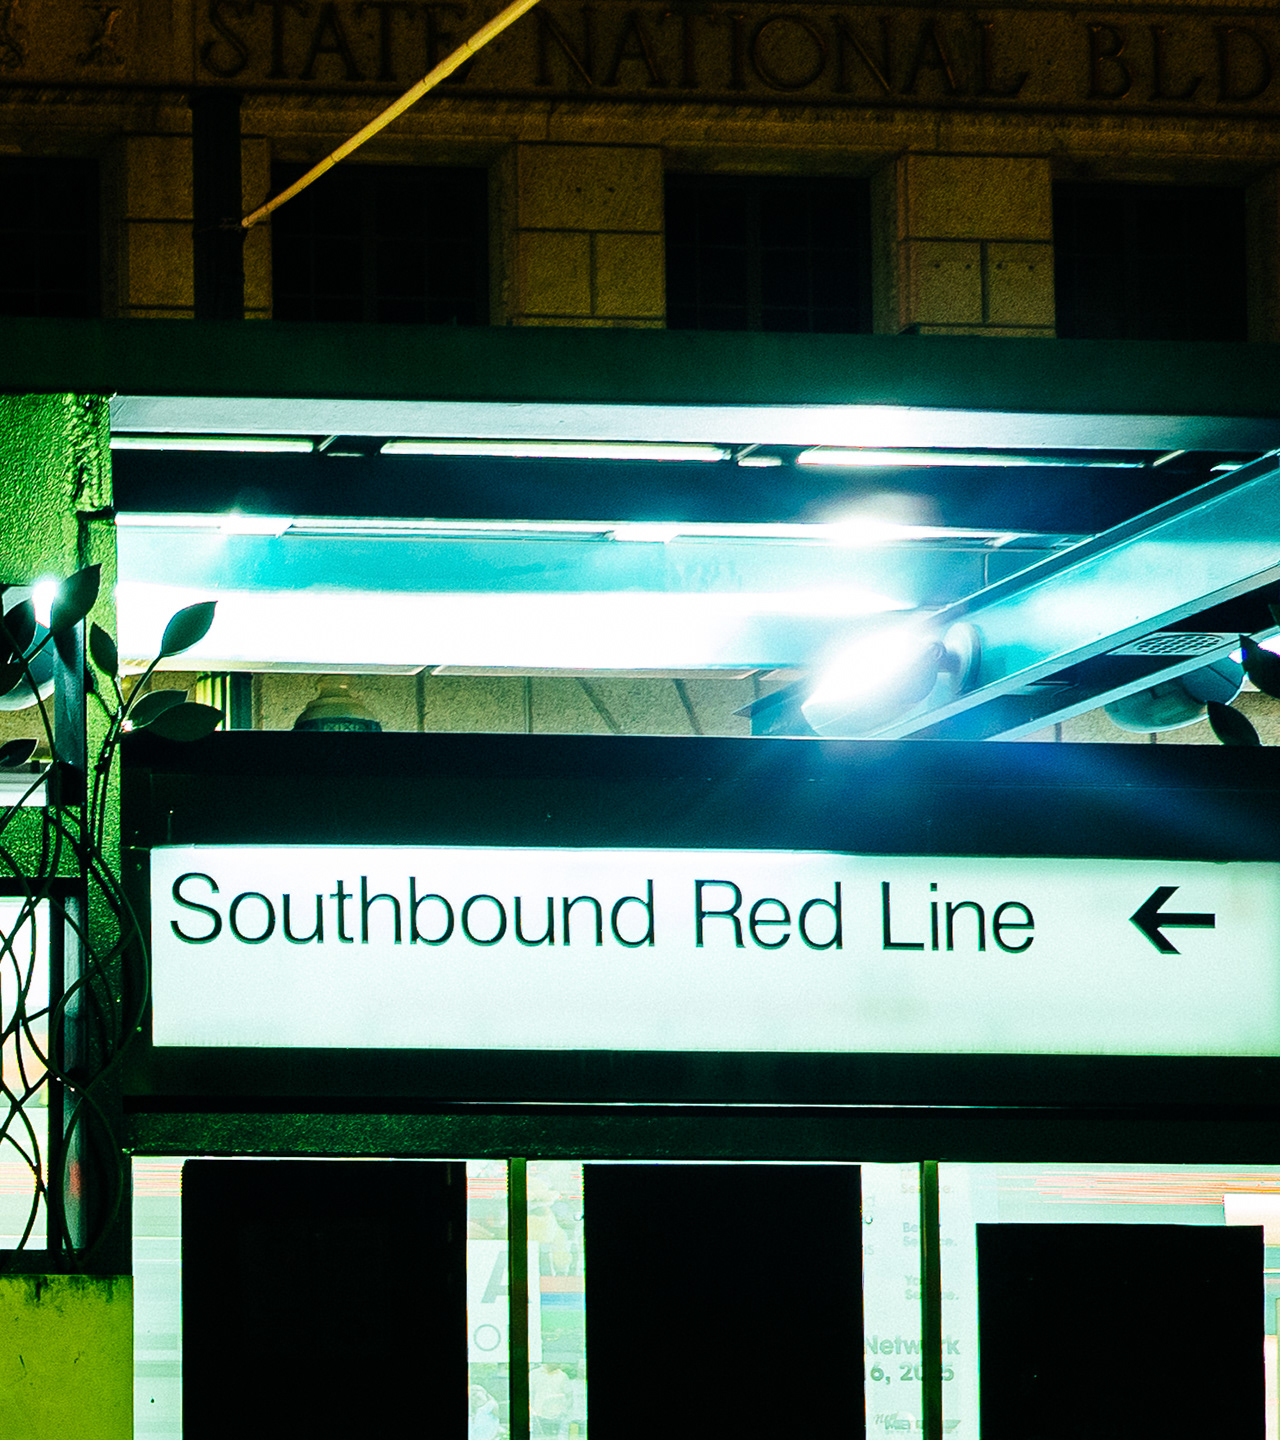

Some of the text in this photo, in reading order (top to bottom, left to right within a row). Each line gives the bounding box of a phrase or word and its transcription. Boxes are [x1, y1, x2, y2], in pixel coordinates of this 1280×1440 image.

[199, 0, 475, 84] STATE
[531, 6, 1030, 98] NATIONAL
[169, 871, 1038, 955] Southbound Red Line
